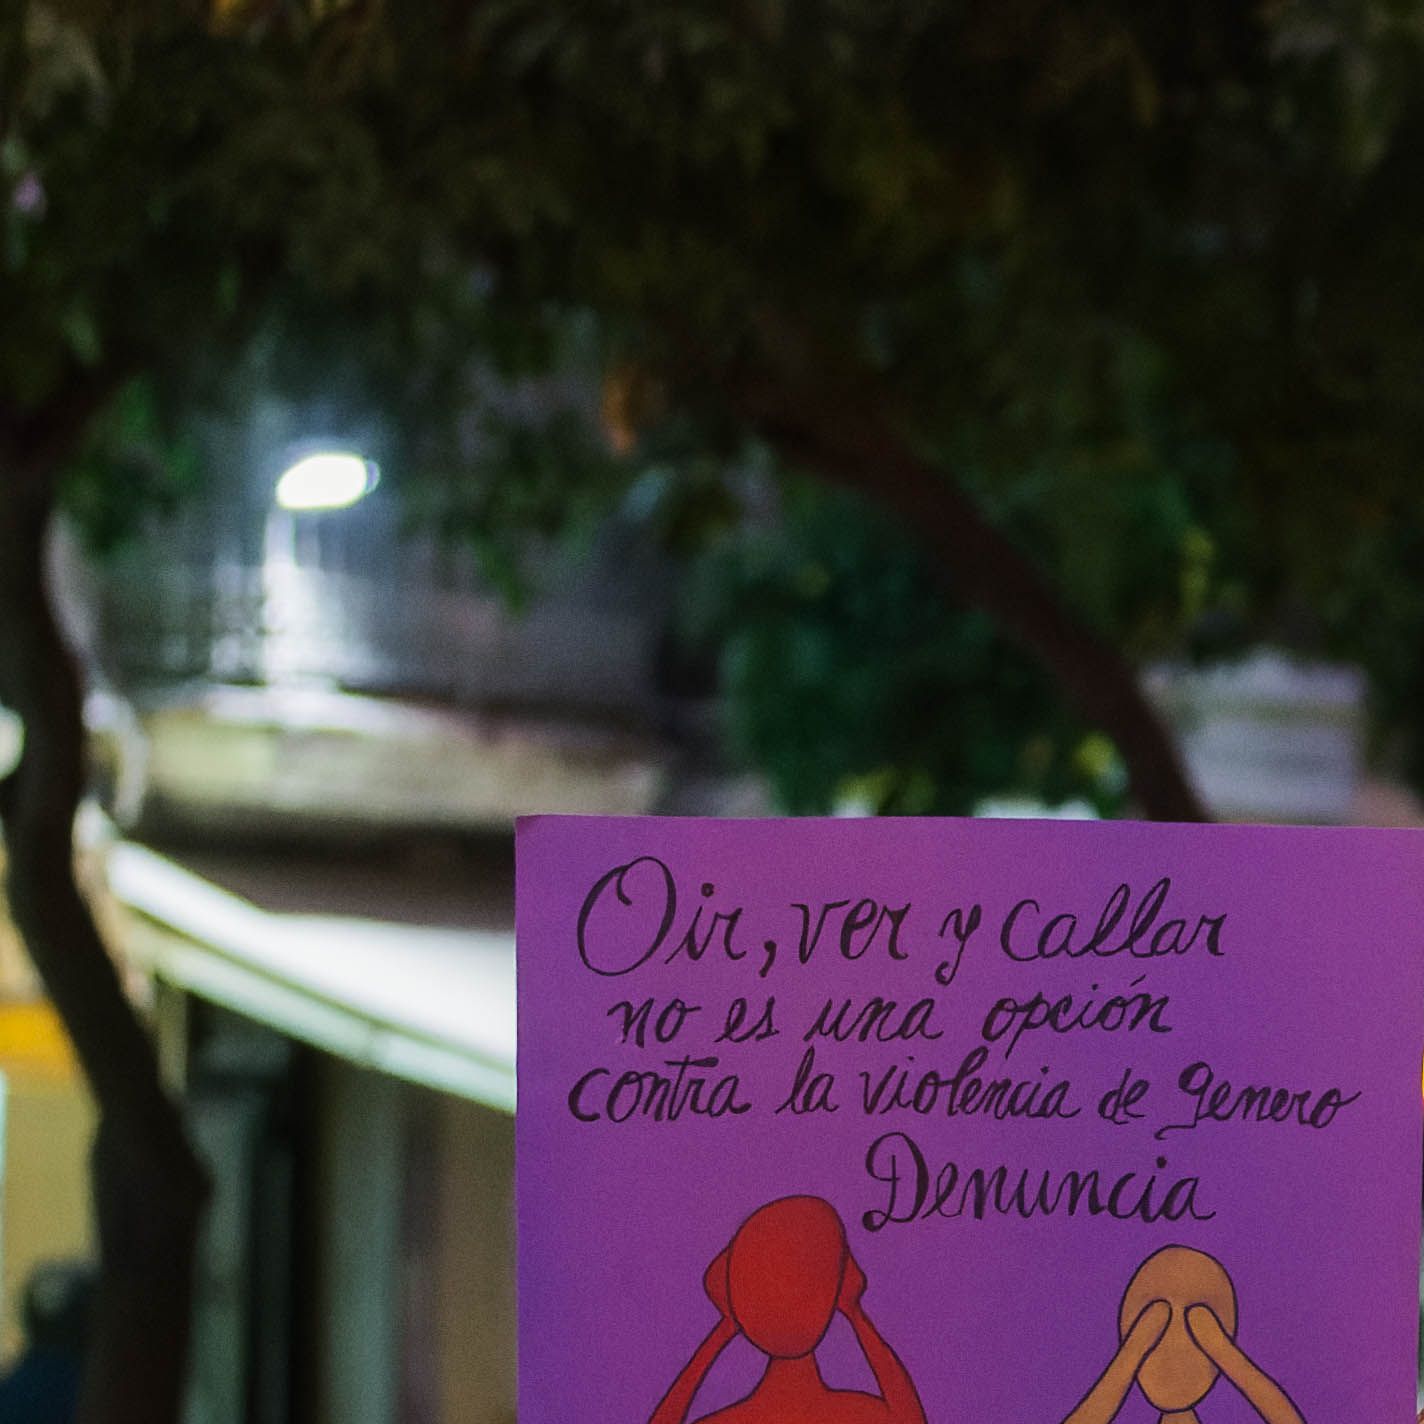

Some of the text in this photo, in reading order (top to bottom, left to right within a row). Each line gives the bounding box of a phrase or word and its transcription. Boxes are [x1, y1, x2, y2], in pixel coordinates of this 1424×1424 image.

[577, 856, 777, 977] Oir,
[791, 896, 910, 962] ver
[936, 905, 983, 985] y
[606, 974, 1175, 1059] no es una opción
[774, 1046, 840, 1116] la
[859, 1045, 1081, 1121] violencia
[1098, 1068, 1151, 1127] de
[861, 1132, 1217, 1233] Denuncia
